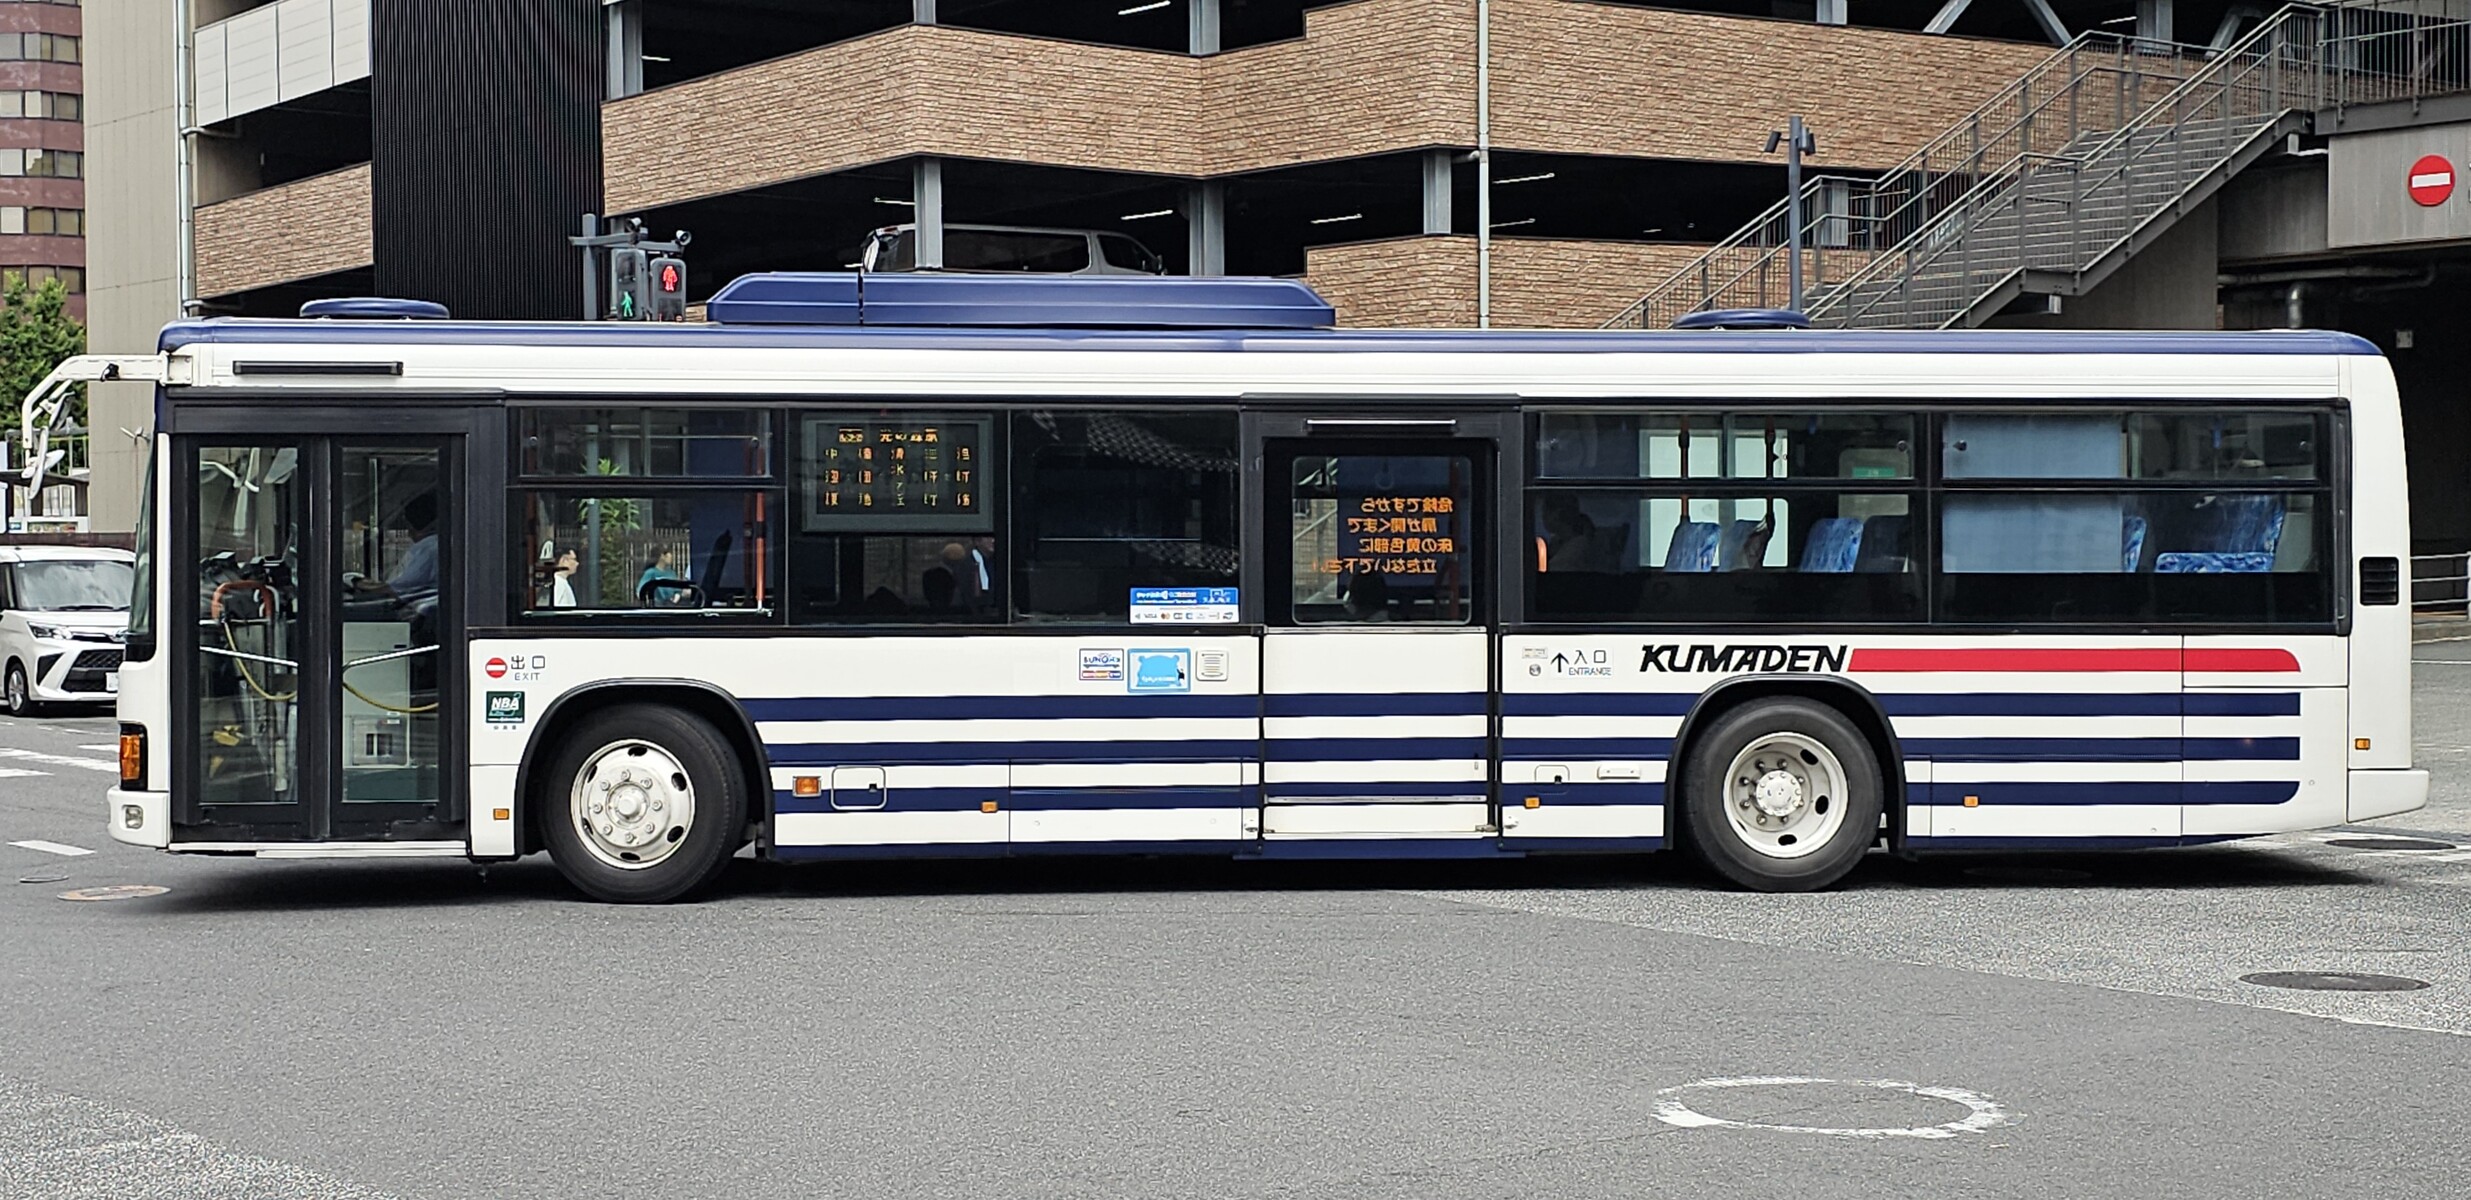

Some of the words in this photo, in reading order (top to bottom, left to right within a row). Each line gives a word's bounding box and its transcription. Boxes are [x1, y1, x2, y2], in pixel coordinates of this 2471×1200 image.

[511, 655, 546, 669] 出口
[1574, 649, 1607, 664] 入口
[1639, 645, 1848, 672] KUMADEN
[514, 672, 541, 681] EXIT
[1568, 667, 1612, 676] ENTRANCE
[490, 696, 520, 711] NBA
